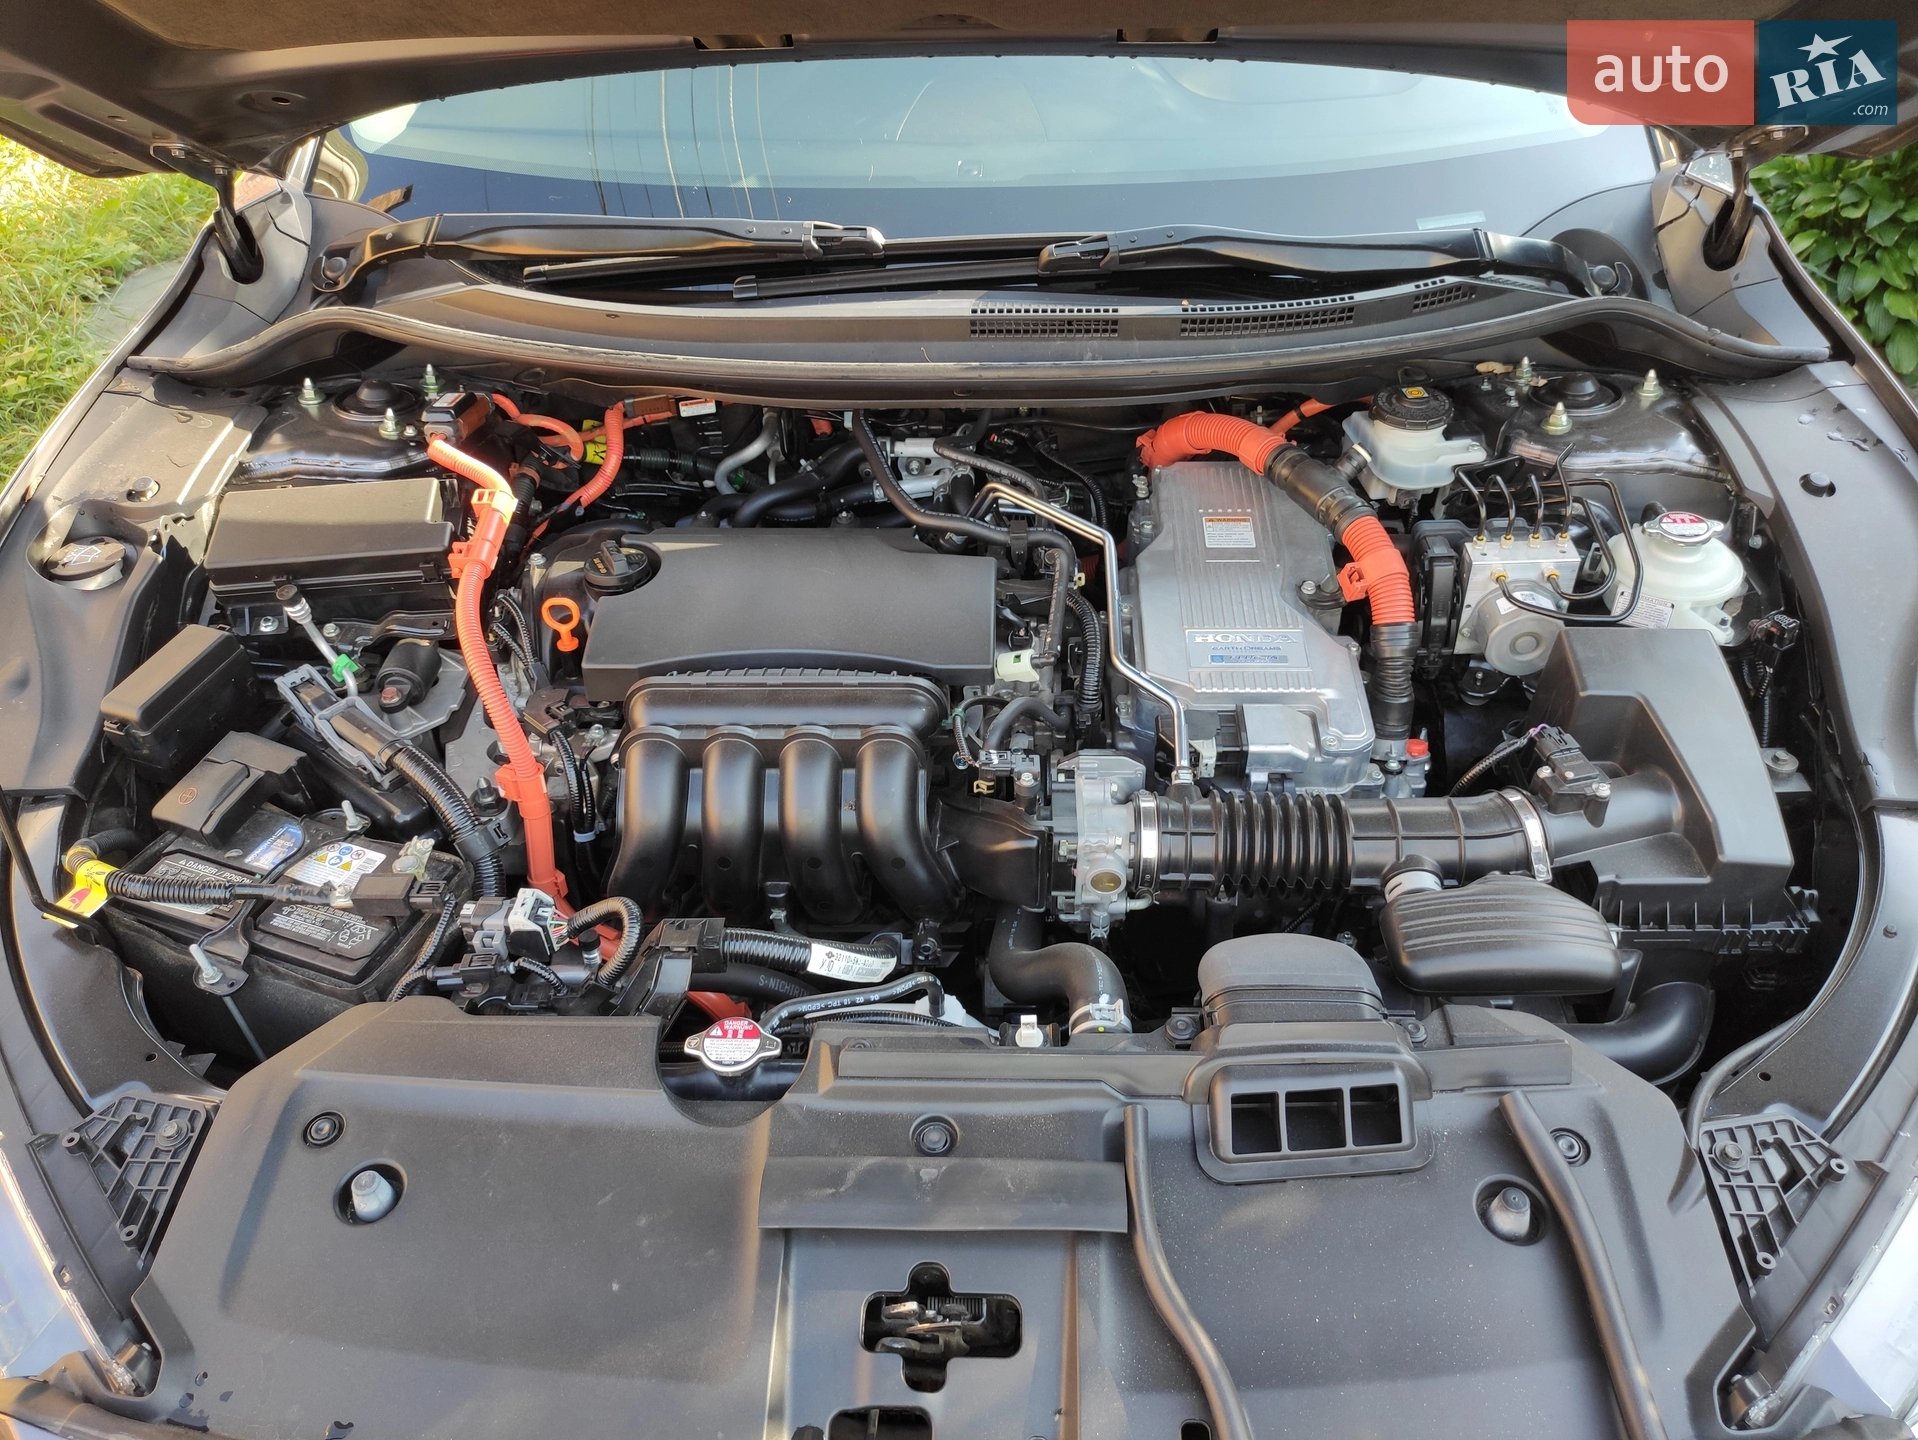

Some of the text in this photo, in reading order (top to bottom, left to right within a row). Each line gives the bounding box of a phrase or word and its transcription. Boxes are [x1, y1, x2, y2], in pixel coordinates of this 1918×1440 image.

[1192, 633, 1299, 644] HONDA
[185, 859, 218, 876] DANGER
[827, 999, 842, 1009] TPC
